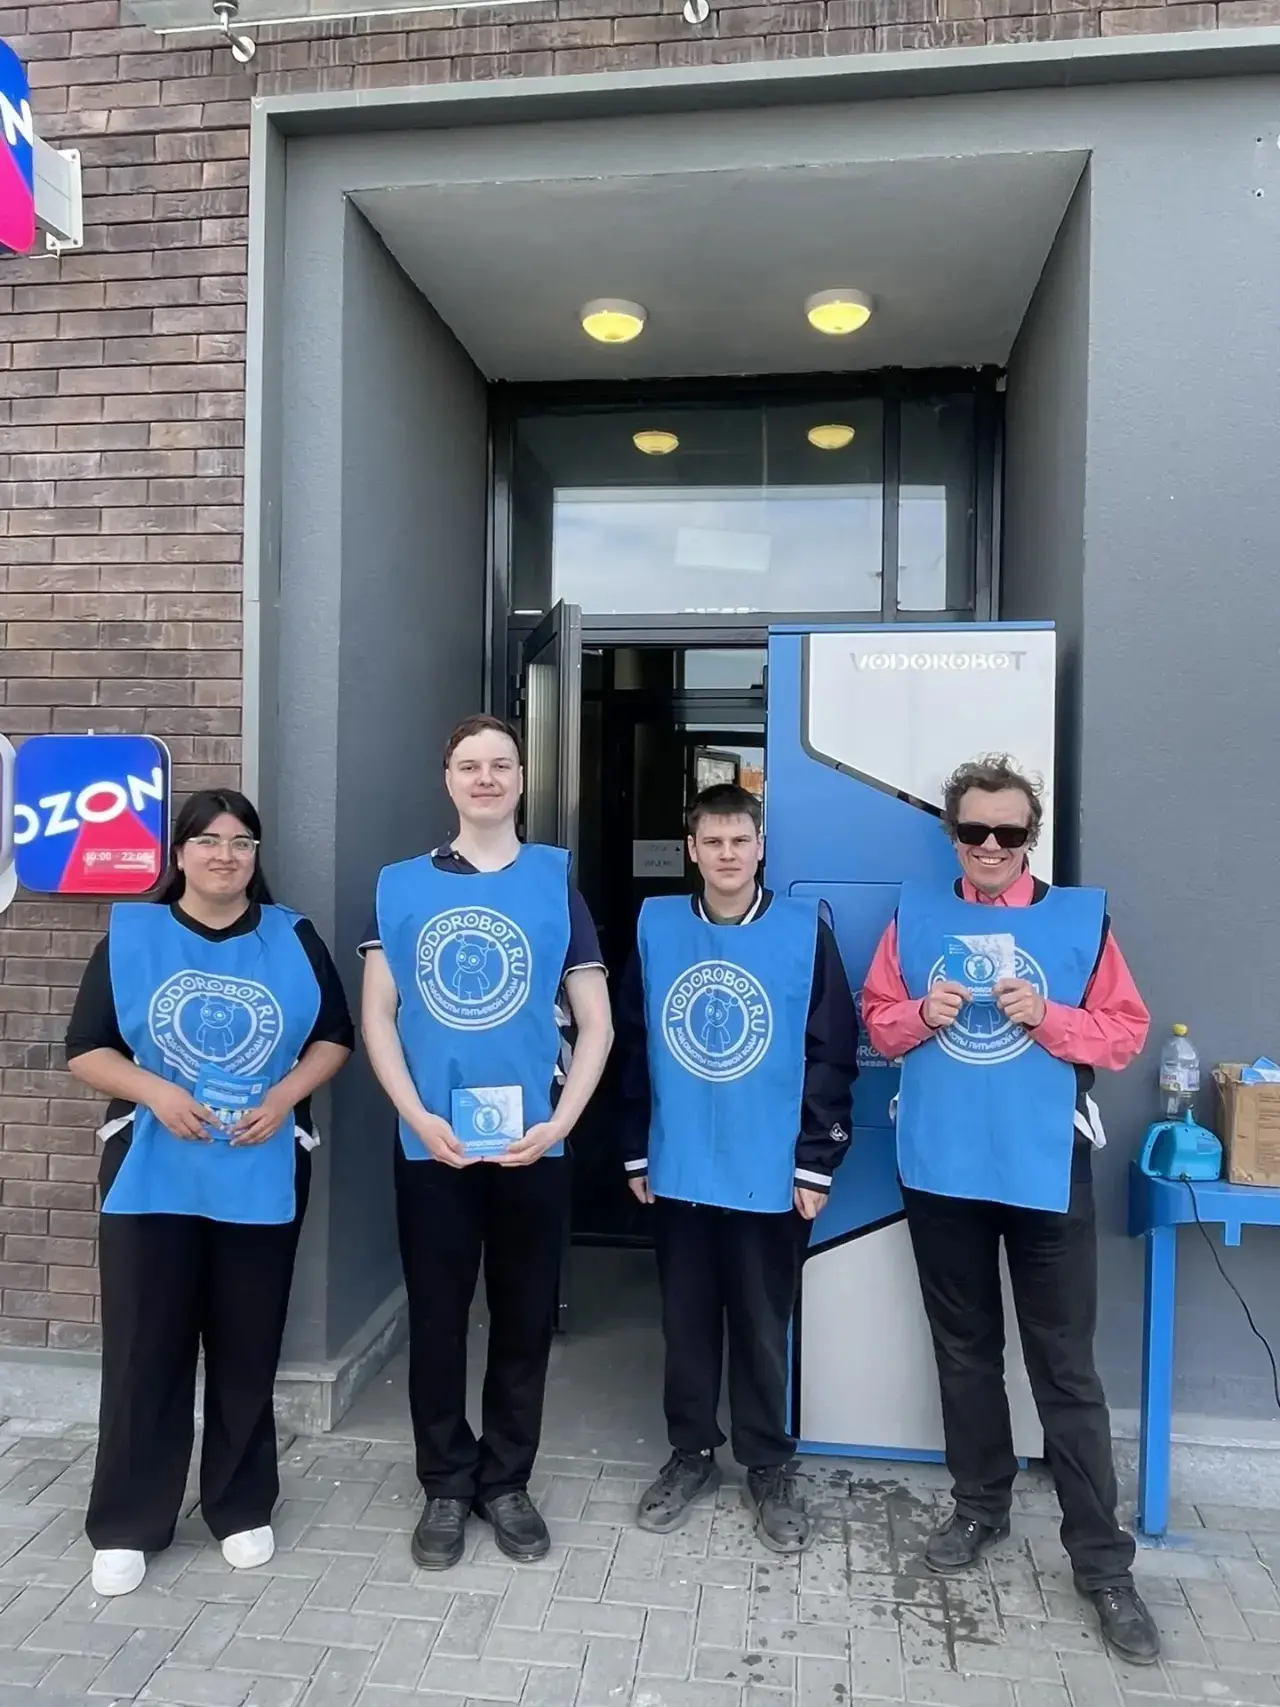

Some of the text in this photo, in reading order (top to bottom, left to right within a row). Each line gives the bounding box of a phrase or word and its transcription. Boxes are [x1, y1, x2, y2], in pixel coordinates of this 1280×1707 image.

[850, 651, 1026, 671] VODOROBOT
[13, 767, 163, 845] OZON
[419, 912, 526, 976] VODOROBOT.RU
[155, 976, 275, 1035] VODOROBOT.RU
[668, 966, 766, 1033] VODOROBOT.RU
